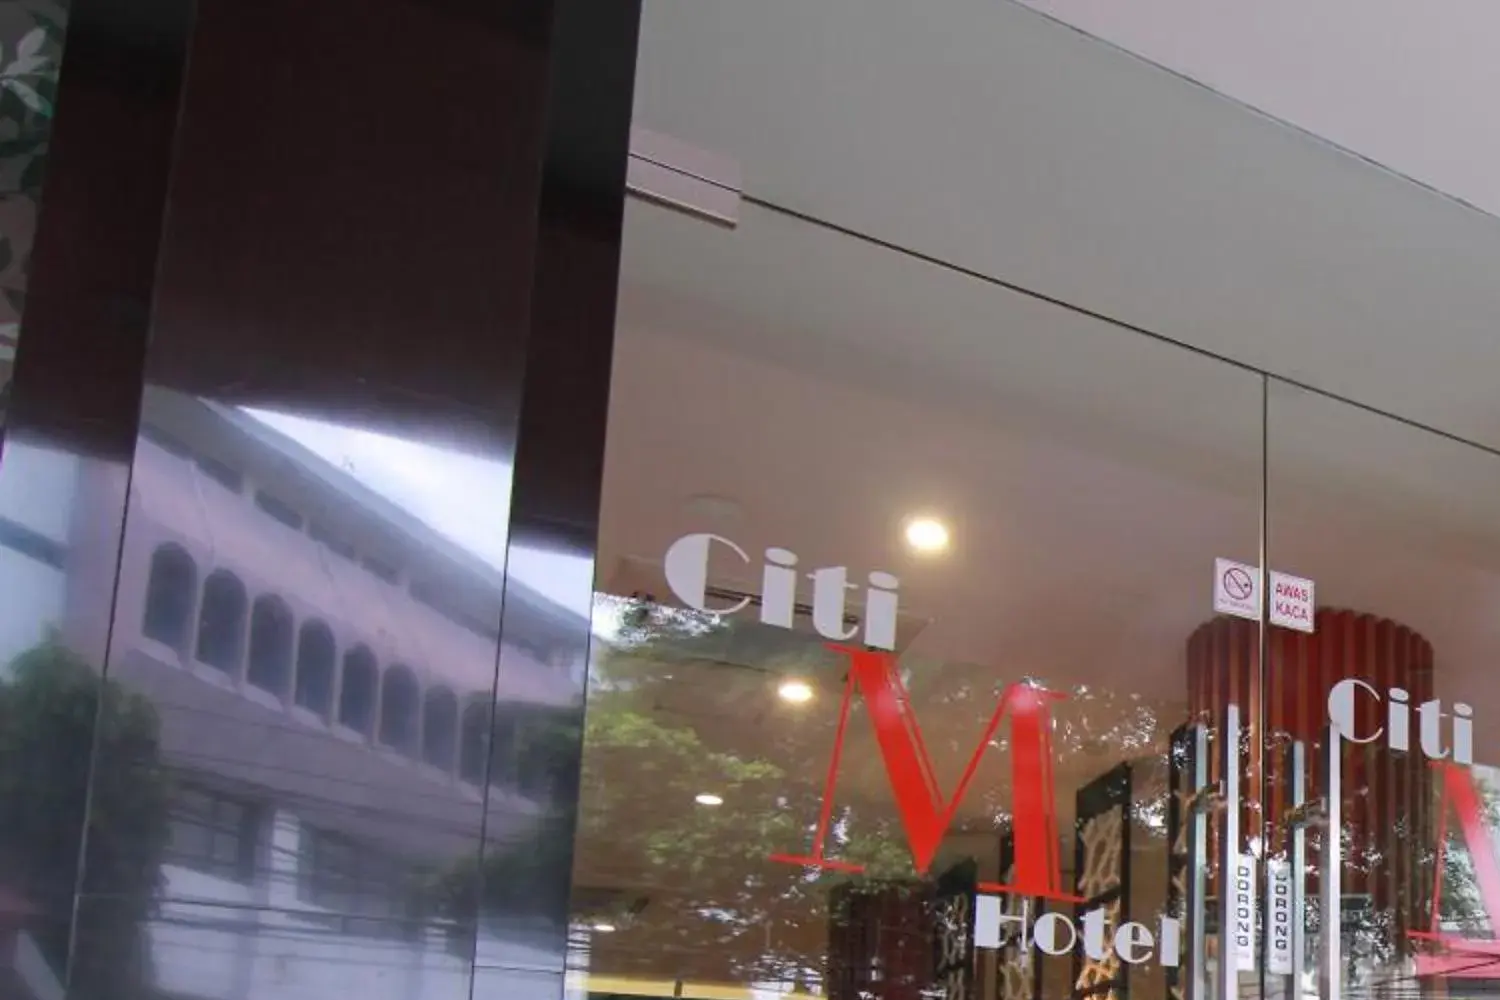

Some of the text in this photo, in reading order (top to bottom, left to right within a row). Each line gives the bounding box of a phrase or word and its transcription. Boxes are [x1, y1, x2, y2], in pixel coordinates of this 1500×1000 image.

[664, 532, 899, 650] Citi
[1275, 582, 1309, 602] AWAS
[1275, 600, 1309, 622] KACA
[1328, 678, 1473, 764] Citi
[769, 643, 1087, 902] M
[976, 895, 1180, 966] Hotel
[1237, 865, 1250, 947] DORONG
